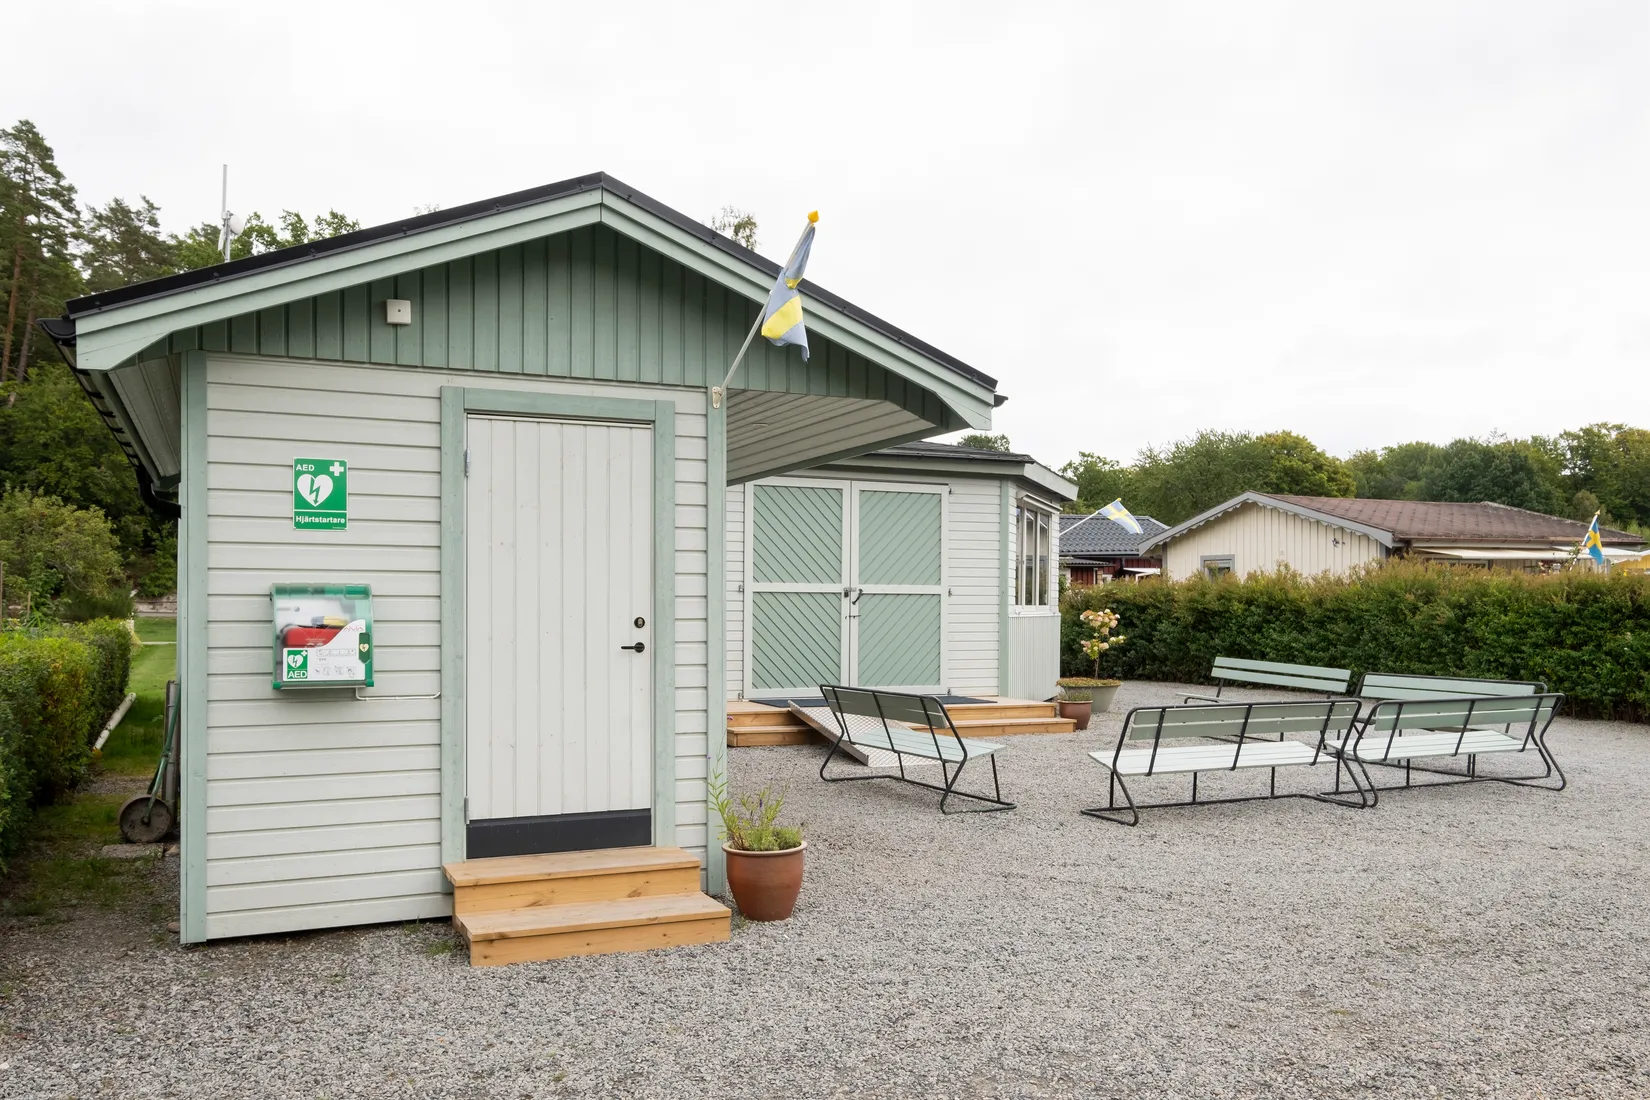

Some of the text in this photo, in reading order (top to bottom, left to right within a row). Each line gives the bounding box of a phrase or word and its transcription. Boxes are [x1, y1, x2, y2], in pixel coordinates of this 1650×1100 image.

[295, 464, 315, 472] AED
[295, 515, 346, 524] Hjärtstartare
[287, 670, 308, 678] AED
